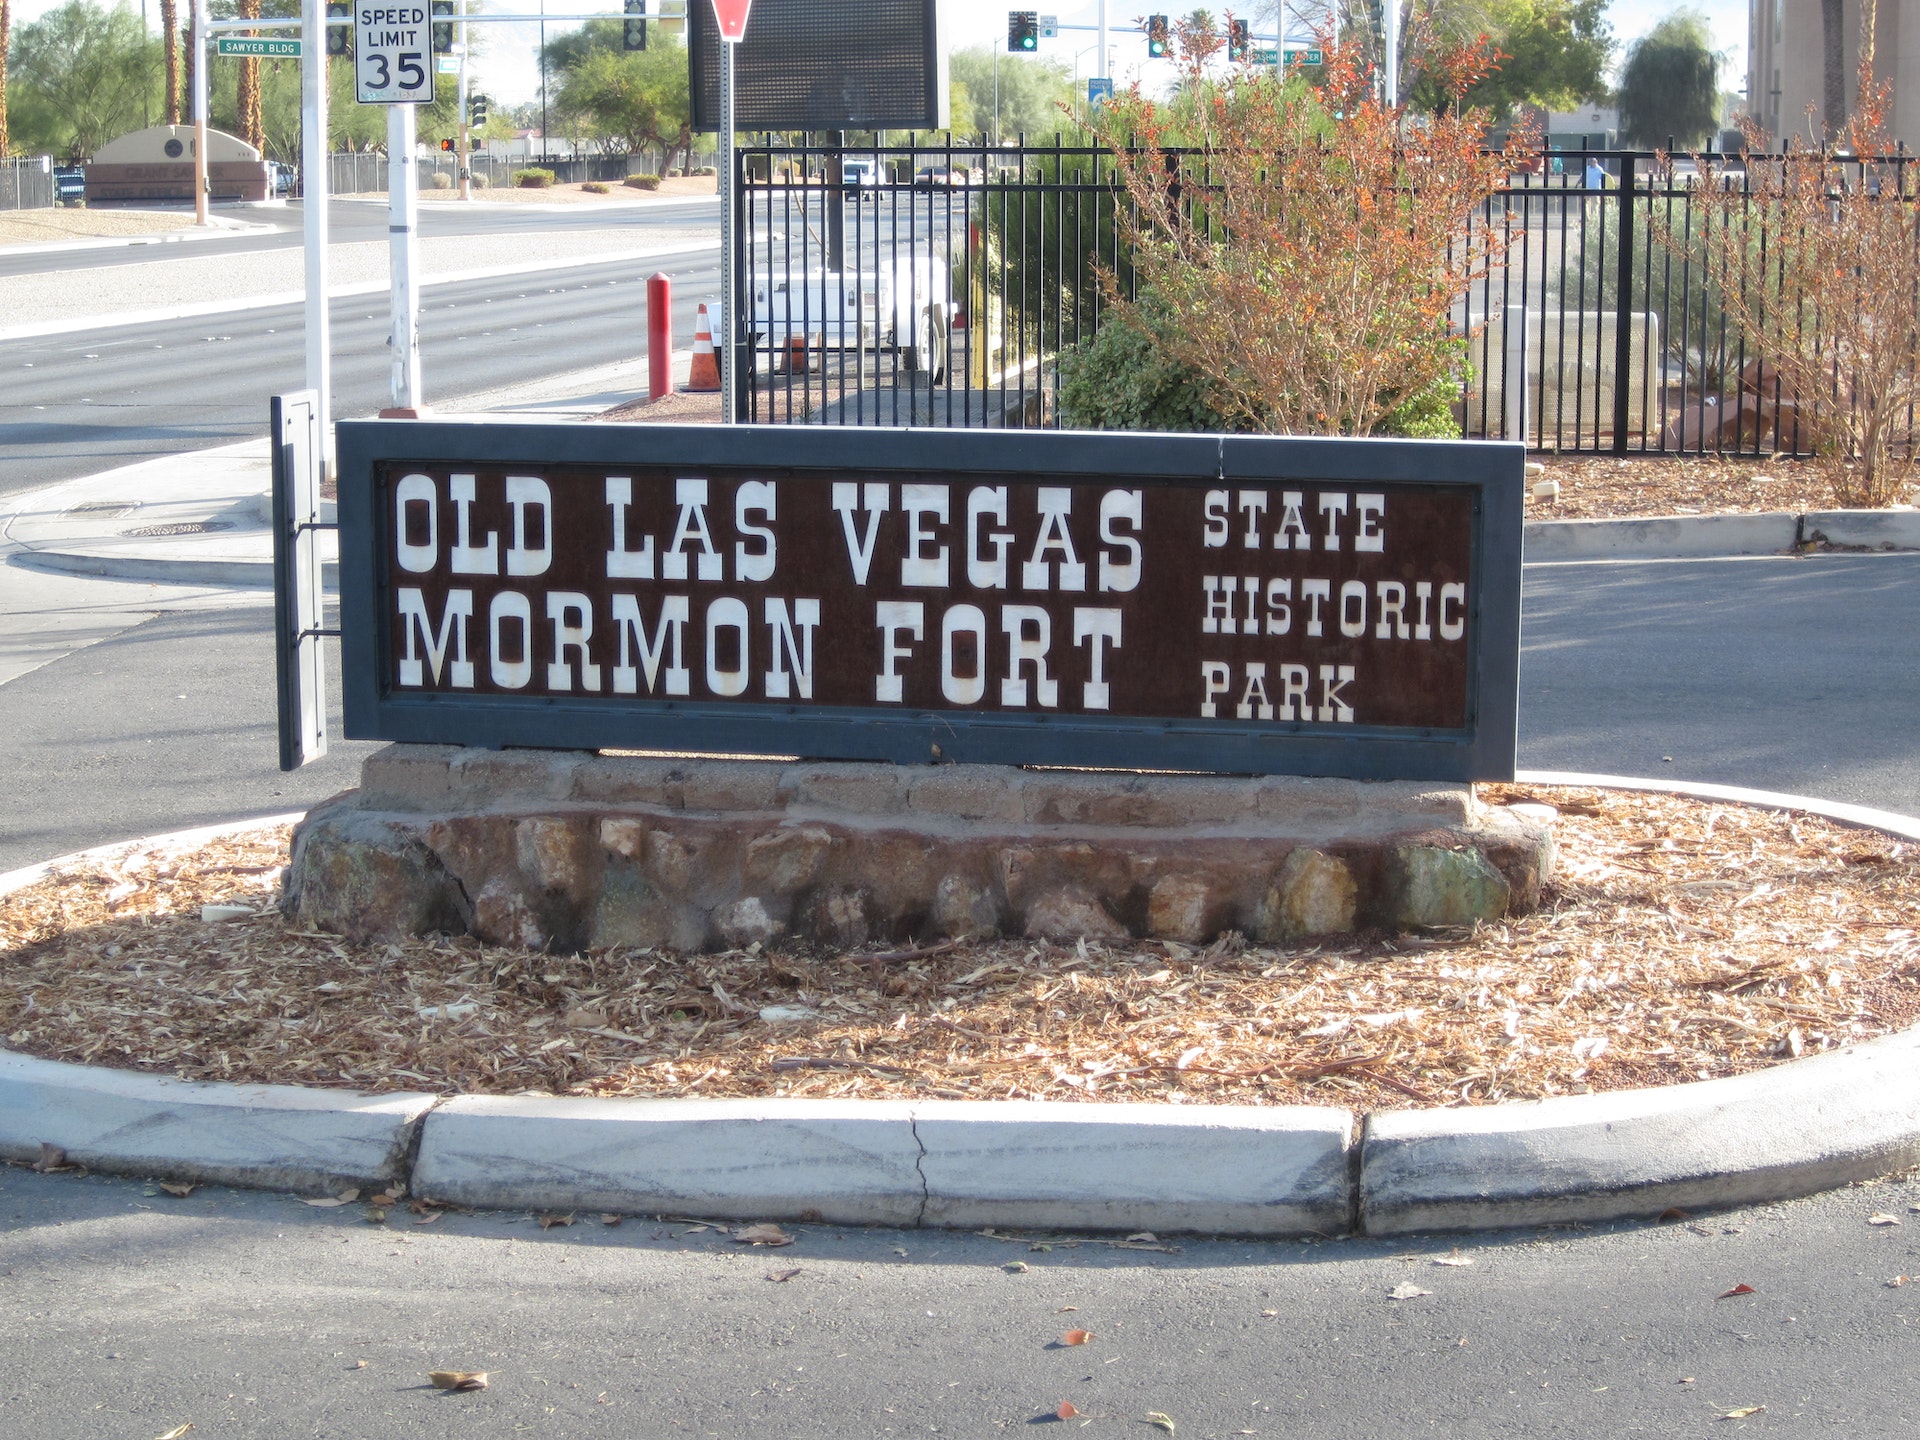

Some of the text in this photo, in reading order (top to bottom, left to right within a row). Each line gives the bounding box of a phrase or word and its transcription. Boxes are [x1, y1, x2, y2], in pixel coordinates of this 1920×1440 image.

[225, 42, 295, 53] SAWYER BLDG
[361, 9, 424, 25] SPEED
[368, 31, 417, 47] LIMIT
[364, 53, 425, 89] 35
[396, 473, 1143, 593] OLD LAS VEGAS
[1203, 489, 1385, 553] STATE
[1202, 575, 1465, 641] HISTORIC
[398, 587, 1122, 710] MORMON FORT
[1201, 661, 1356, 723] PARK
